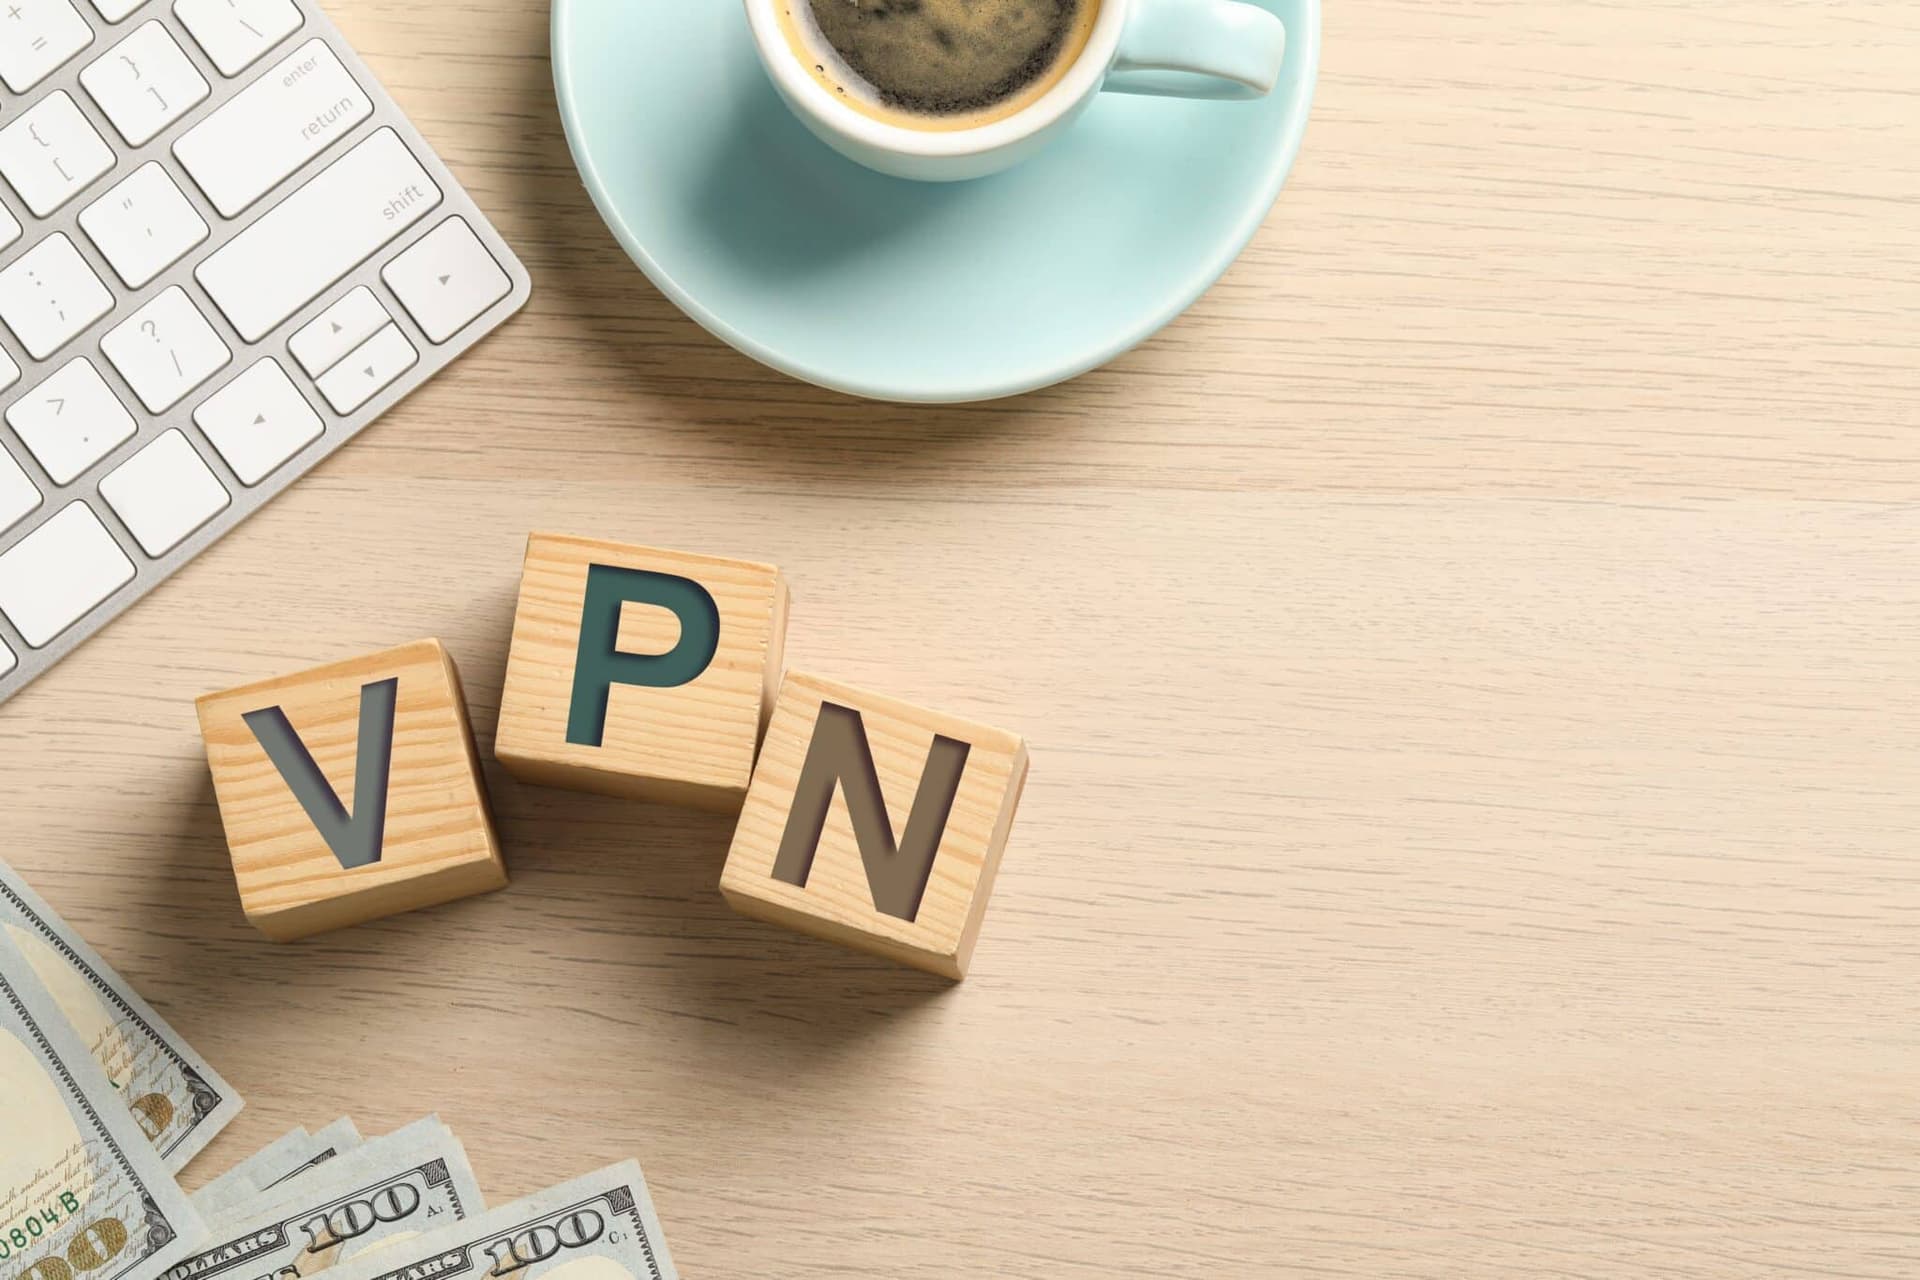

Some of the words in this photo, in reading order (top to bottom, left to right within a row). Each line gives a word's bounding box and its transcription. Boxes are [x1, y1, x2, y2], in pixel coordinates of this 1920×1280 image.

[281, 55, 319, 88] enter
[300, 97, 354, 141] return
[382, 184, 424, 221] shift
[300, 1183, 420, 1253] 100
[484, 1208, 605, 1278] 100
